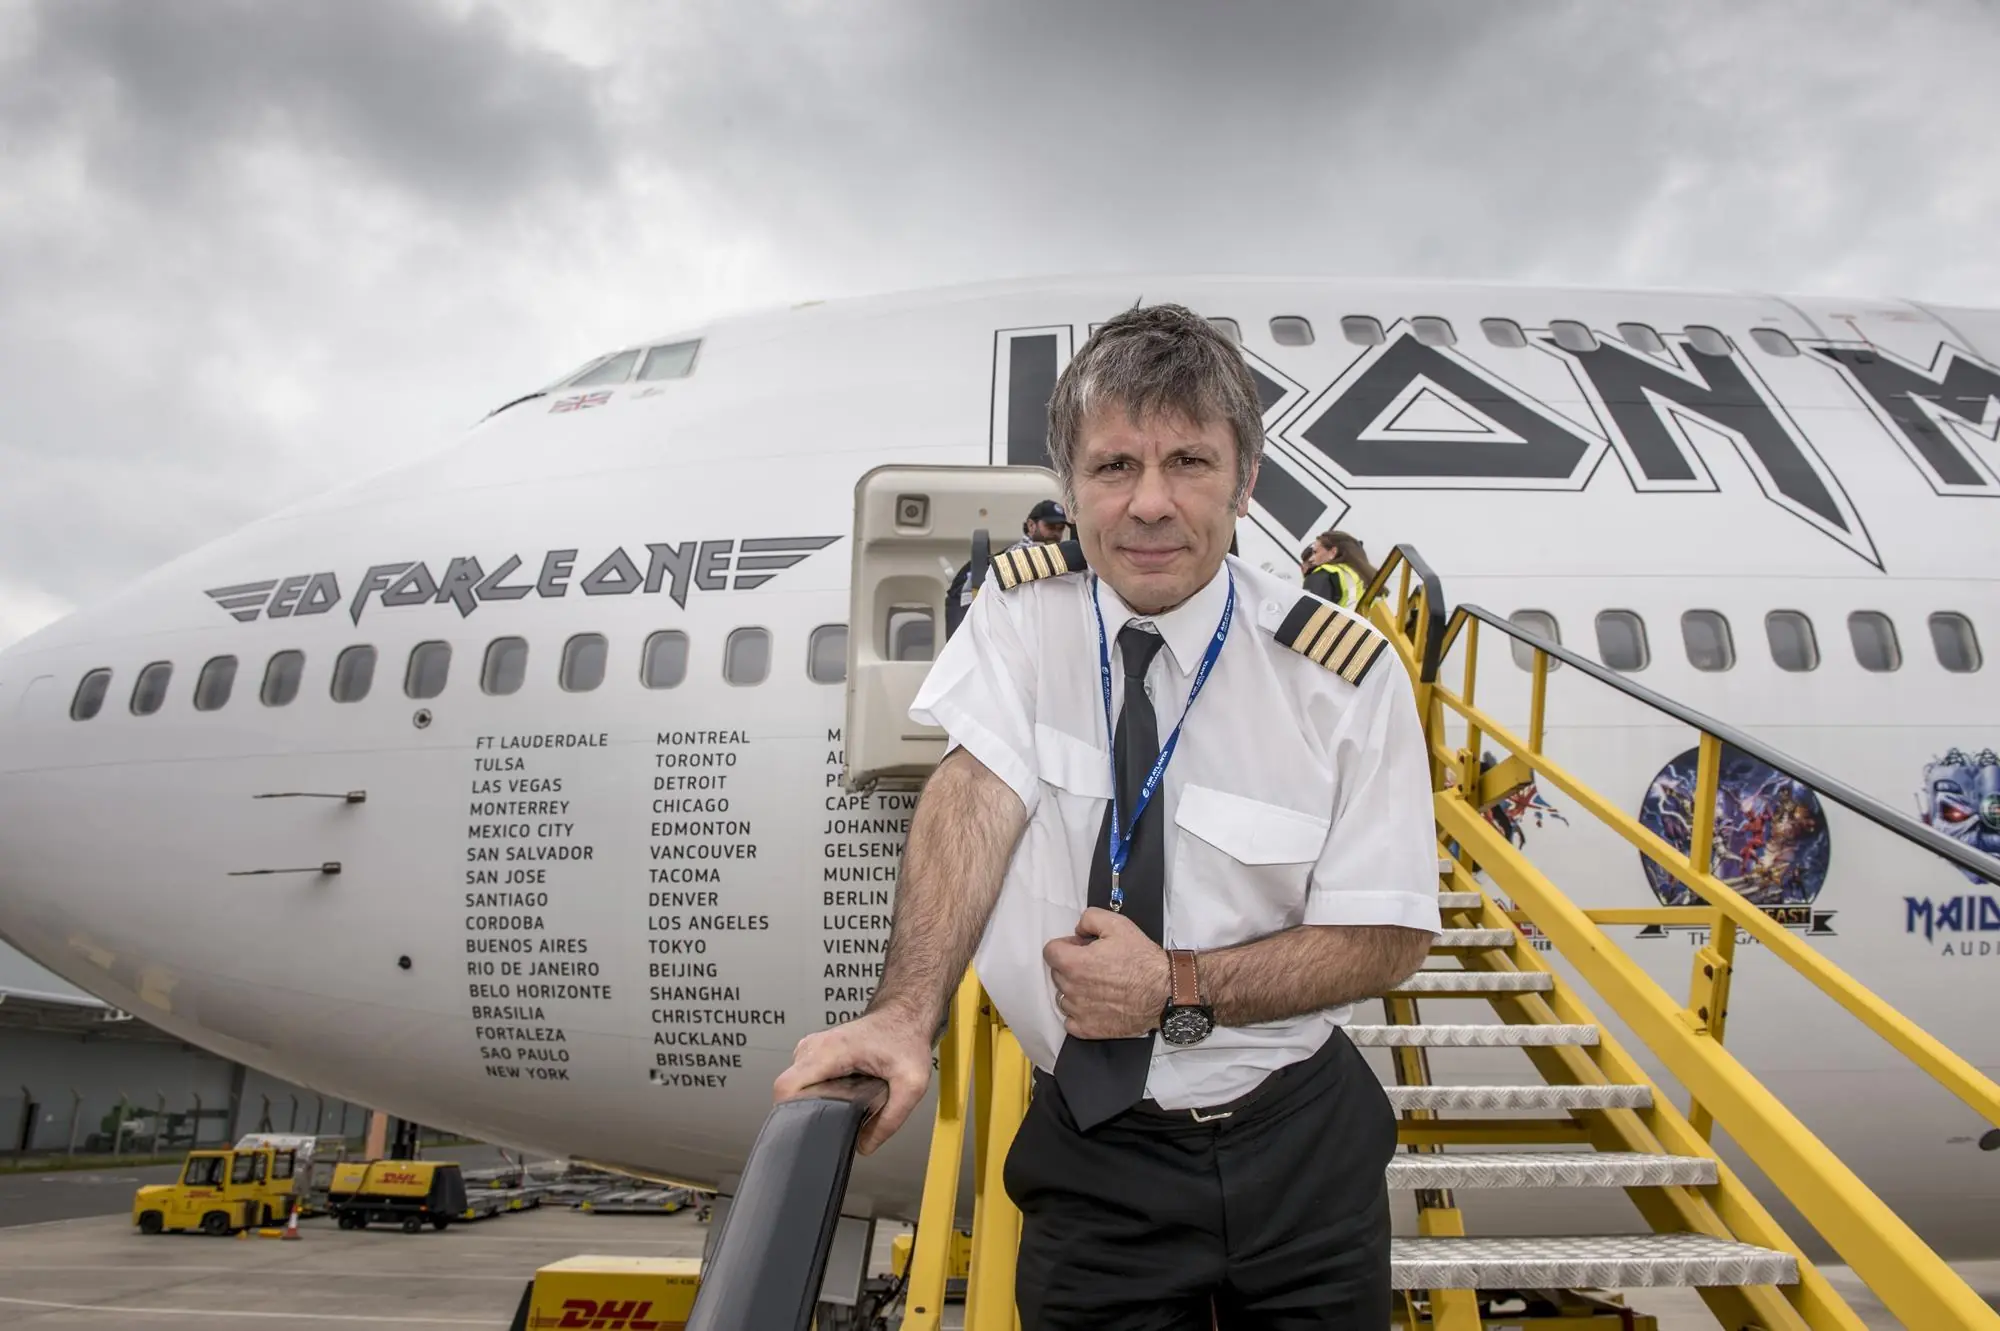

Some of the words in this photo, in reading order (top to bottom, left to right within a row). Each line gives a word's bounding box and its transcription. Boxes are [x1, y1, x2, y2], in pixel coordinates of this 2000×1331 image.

[266, 572, 341, 618] ED
[349, 549, 578, 627] FORCE
[580, 539, 735, 610] ONE
[475, 736, 496, 749] FT
[500, 733, 609, 749] LAUDERDALE
[656, 730, 751, 745] MONTREAL
[473, 757, 526, 771] TULSA
[655, 753, 737, 768] TORONTO
[1152, 750, 1169, 776] ATLANTA
[471, 780, 502, 794] LAS
[508, 778, 563, 792] VEGAS
[653, 775, 728, 790] DETROIT
[469, 800, 571, 816] MONTERREY
[652, 798, 730, 813] CHICAGO
[825, 796, 870, 811] CAPE
[467, 824, 531, 839] MEXICO
[537, 823, 575, 837] CITY
[650, 821, 751, 836] EDMONTON
[466, 847, 500, 862] SAN
[505, 846, 594, 861] SALVADOR
[649, 844, 758, 860] VANCOUVER
[465, 870, 499, 884] SAN
[504, 869, 547, 884] JOSE
[648, 868, 721, 883] TACOMA
[824, 866, 896, 881] MUNICH
[464, 892, 549, 907] SANTIAGO
[648, 892, 719, 907] DENVER
[824, 890, 888, 906] BERLIN
[465, 916, 545, 930] CORDOBA
[648, 916, 682, 930] LOS
[687, 915, 770, 930] ANGELES
[465, 938, 533, 953] BUENOS
[538, 938, 588, 953] AIRES
[647, 939, 707, 954] TOKYO
[466, 961, 495, 975] RIO
[500, 962, 523, 976] DE
[528, 962, 600, 976] JANEIRO
[648, 963, 718, 978] BEIJING
[468, 984, 511, 998] BELO
[516, 984, 613, 999] HORIZONTE
[649, 986, 741, 1001] SHANGHAI
[471, 1006, 546, 1020] BRASILIA
[651, 1009, 786, 1024] CHRISTCHURCH
[475, 1026, 567, 1042] FORTALEZA
[653, 1032, 748, 1046] AUCKLAND
[479, 1047, 512, 1059] SAO
[516, 1048, 570, 1062] PAULO
[655, 1053, 743, 1068] BRISBANE
[485, 1066, 520, 1078] NEW
[525, 1068, 570, 1080] YORK
[558, 1299, 659, 1329] DHL
